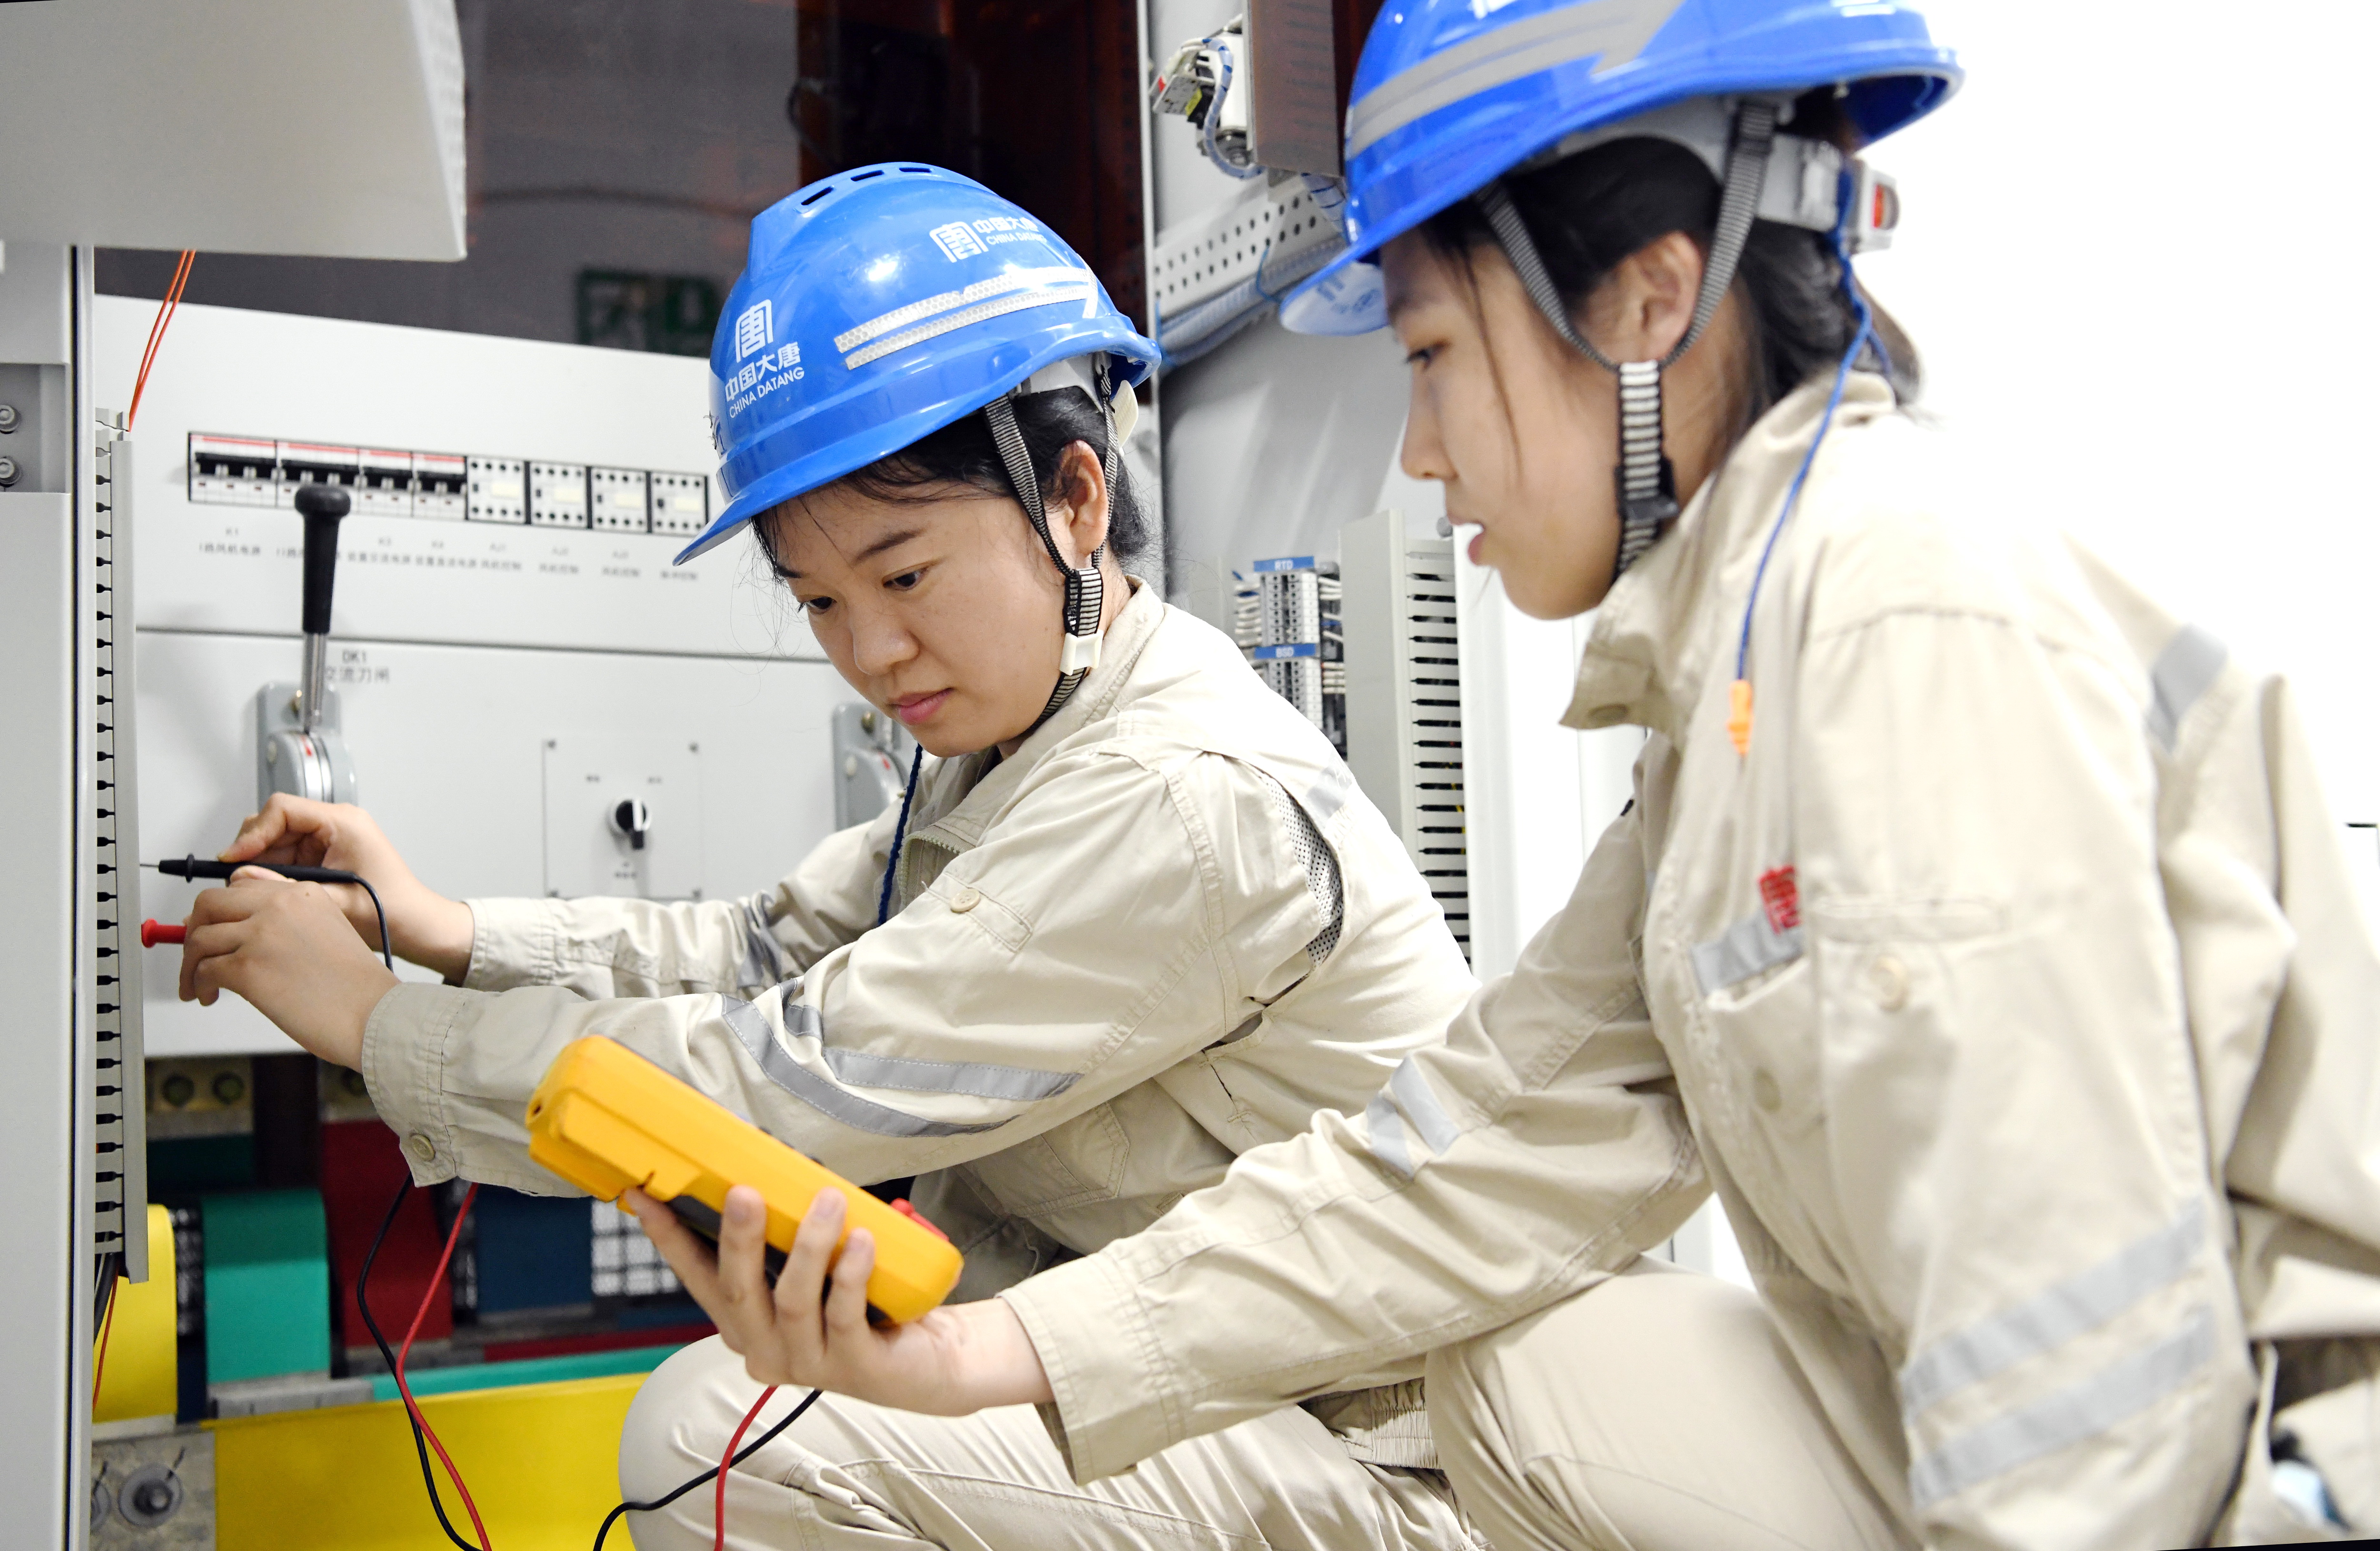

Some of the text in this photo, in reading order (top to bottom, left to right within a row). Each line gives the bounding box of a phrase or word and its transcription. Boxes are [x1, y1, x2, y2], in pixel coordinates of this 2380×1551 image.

[986, 233, 1018, 245] CHINA
[725, 342, 801, 402] 中国大唐
[729, 367, 805, 418] CHINA DATANG
[1274, 560, 1293, 571] RTD
